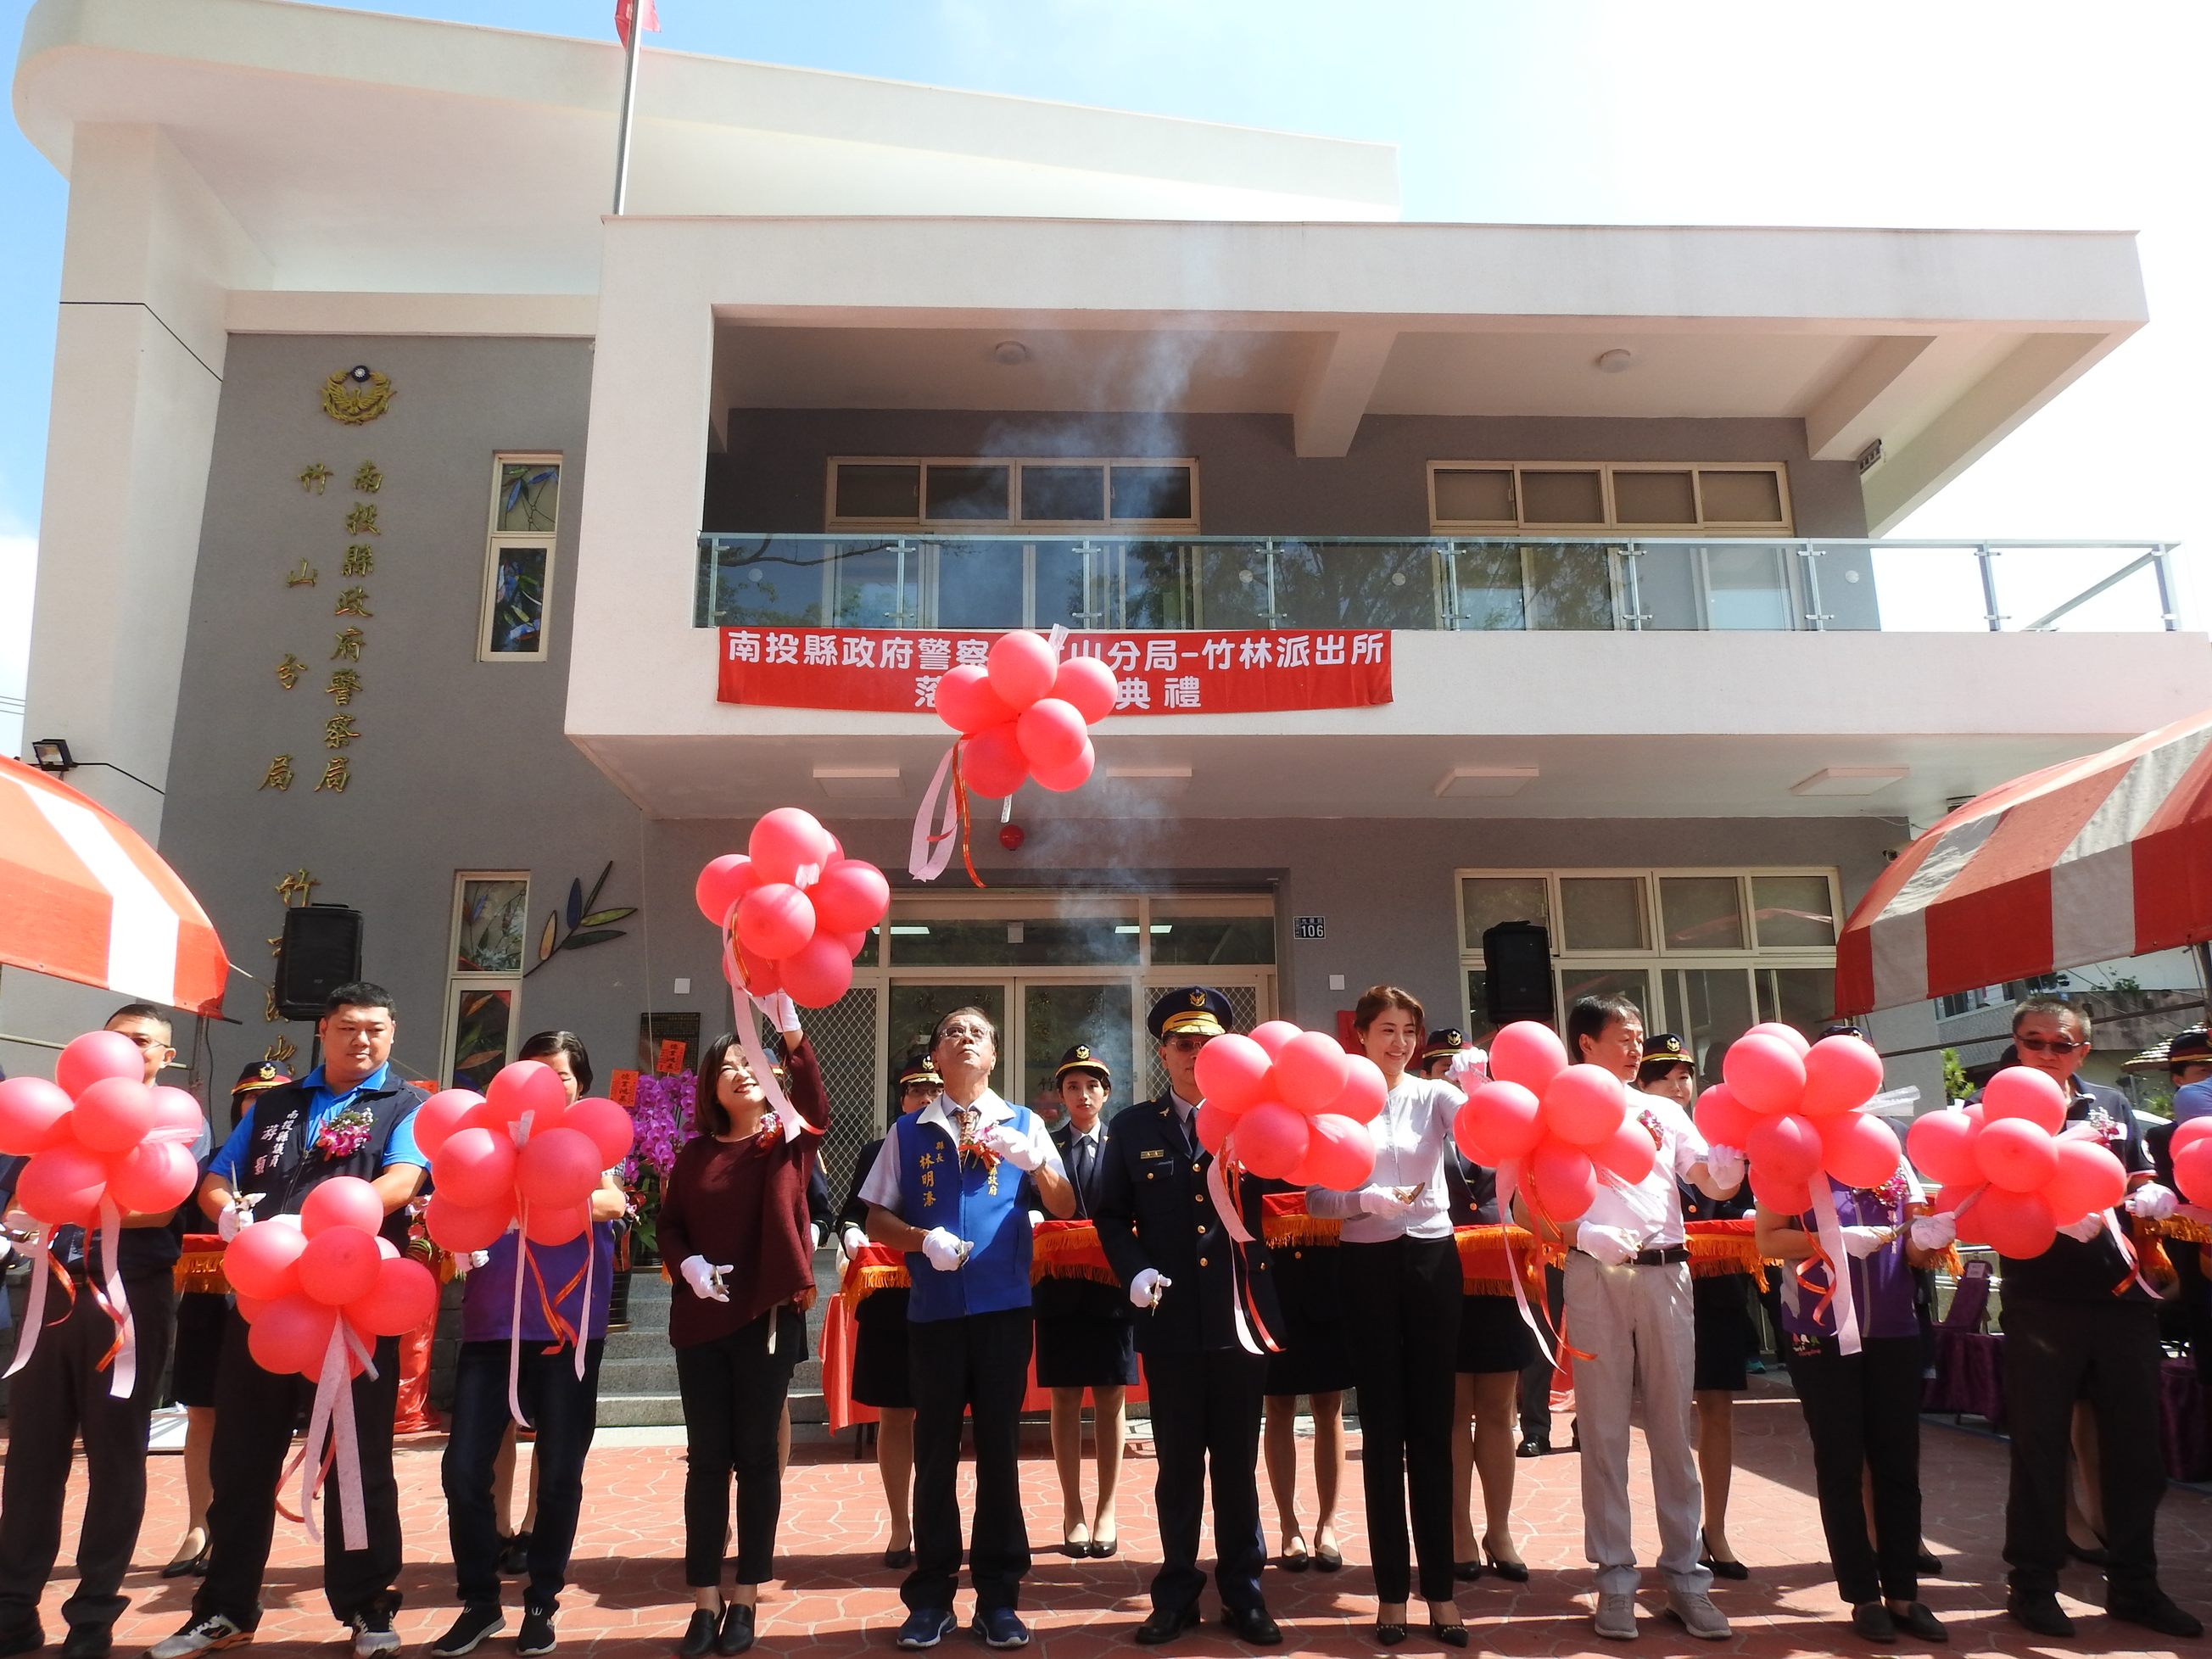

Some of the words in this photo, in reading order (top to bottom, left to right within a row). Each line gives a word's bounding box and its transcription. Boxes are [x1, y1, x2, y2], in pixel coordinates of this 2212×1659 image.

[258, 463, 332, 792] 竹山分局
[314, 459, 385, 794] 南投縣政府警察局
[728, 629, 1385, 671] 南投縣政府警察山分局-竹林派出所
[1301, 924, 1324, 937] 106
